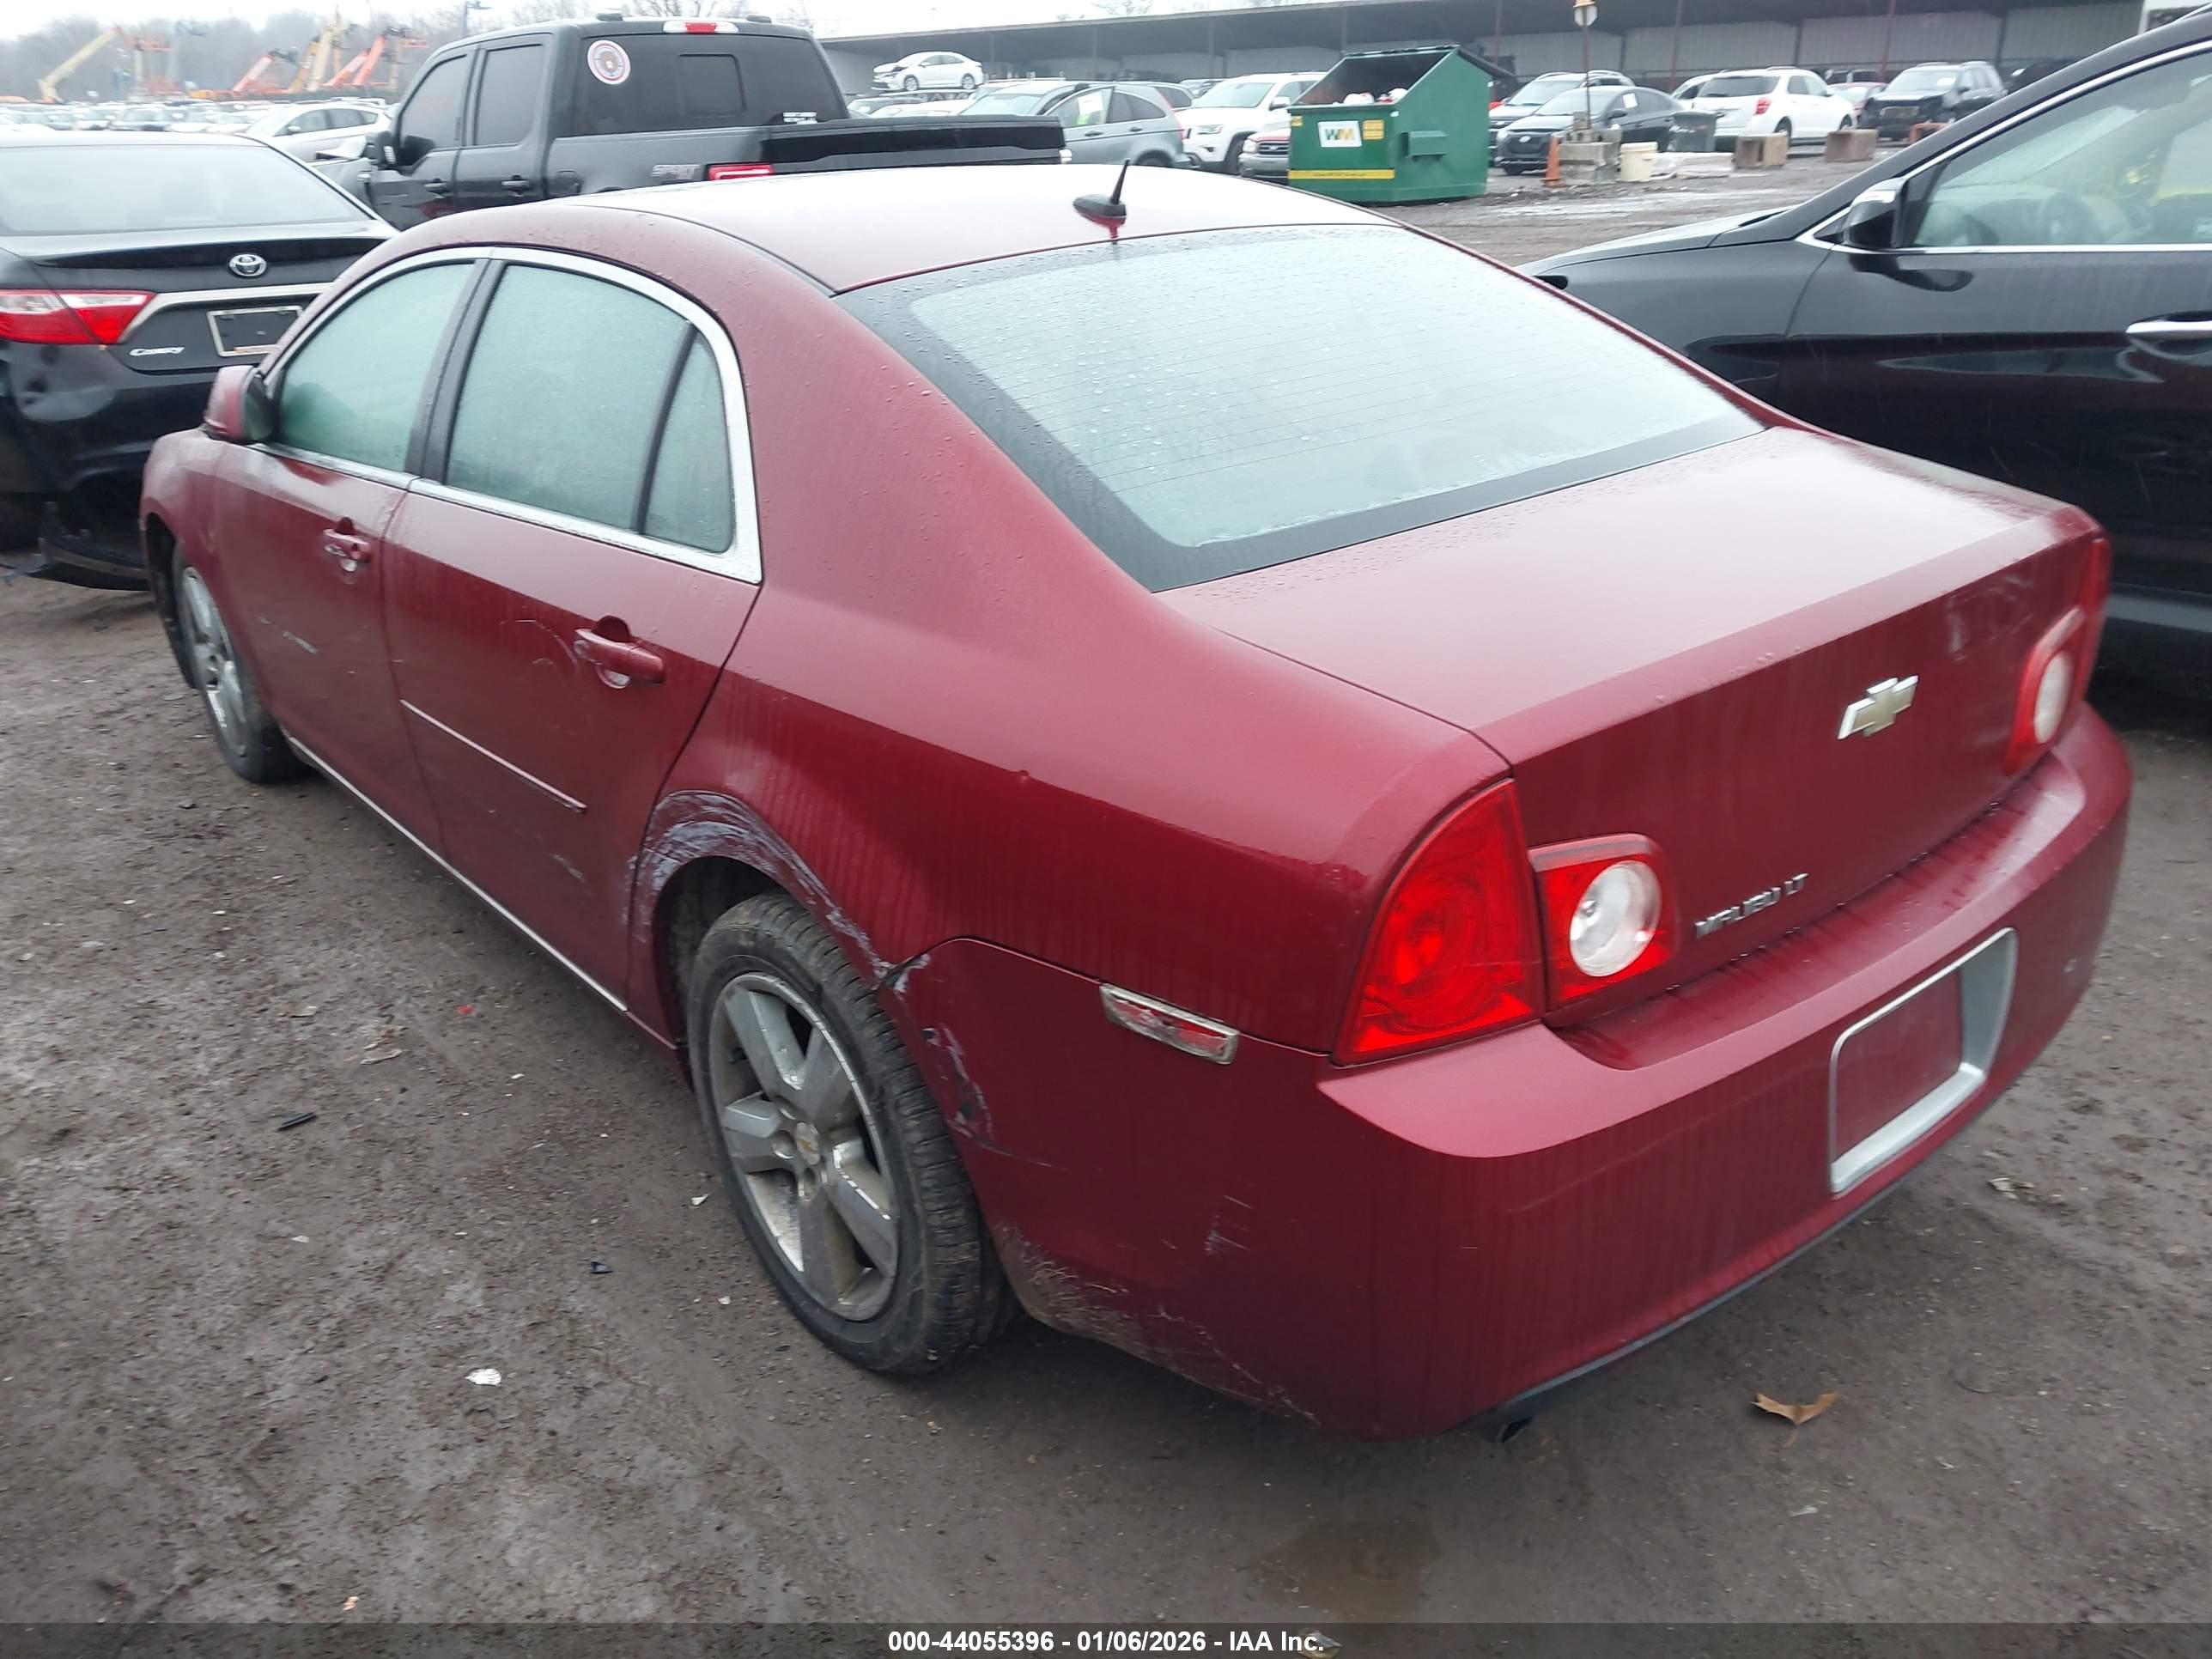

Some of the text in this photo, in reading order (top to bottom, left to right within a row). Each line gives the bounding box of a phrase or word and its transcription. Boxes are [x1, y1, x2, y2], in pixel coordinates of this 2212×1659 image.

[1324, 129, 1356, 141] WM
[1694, 872, 1809, 939] MALIBU LT
